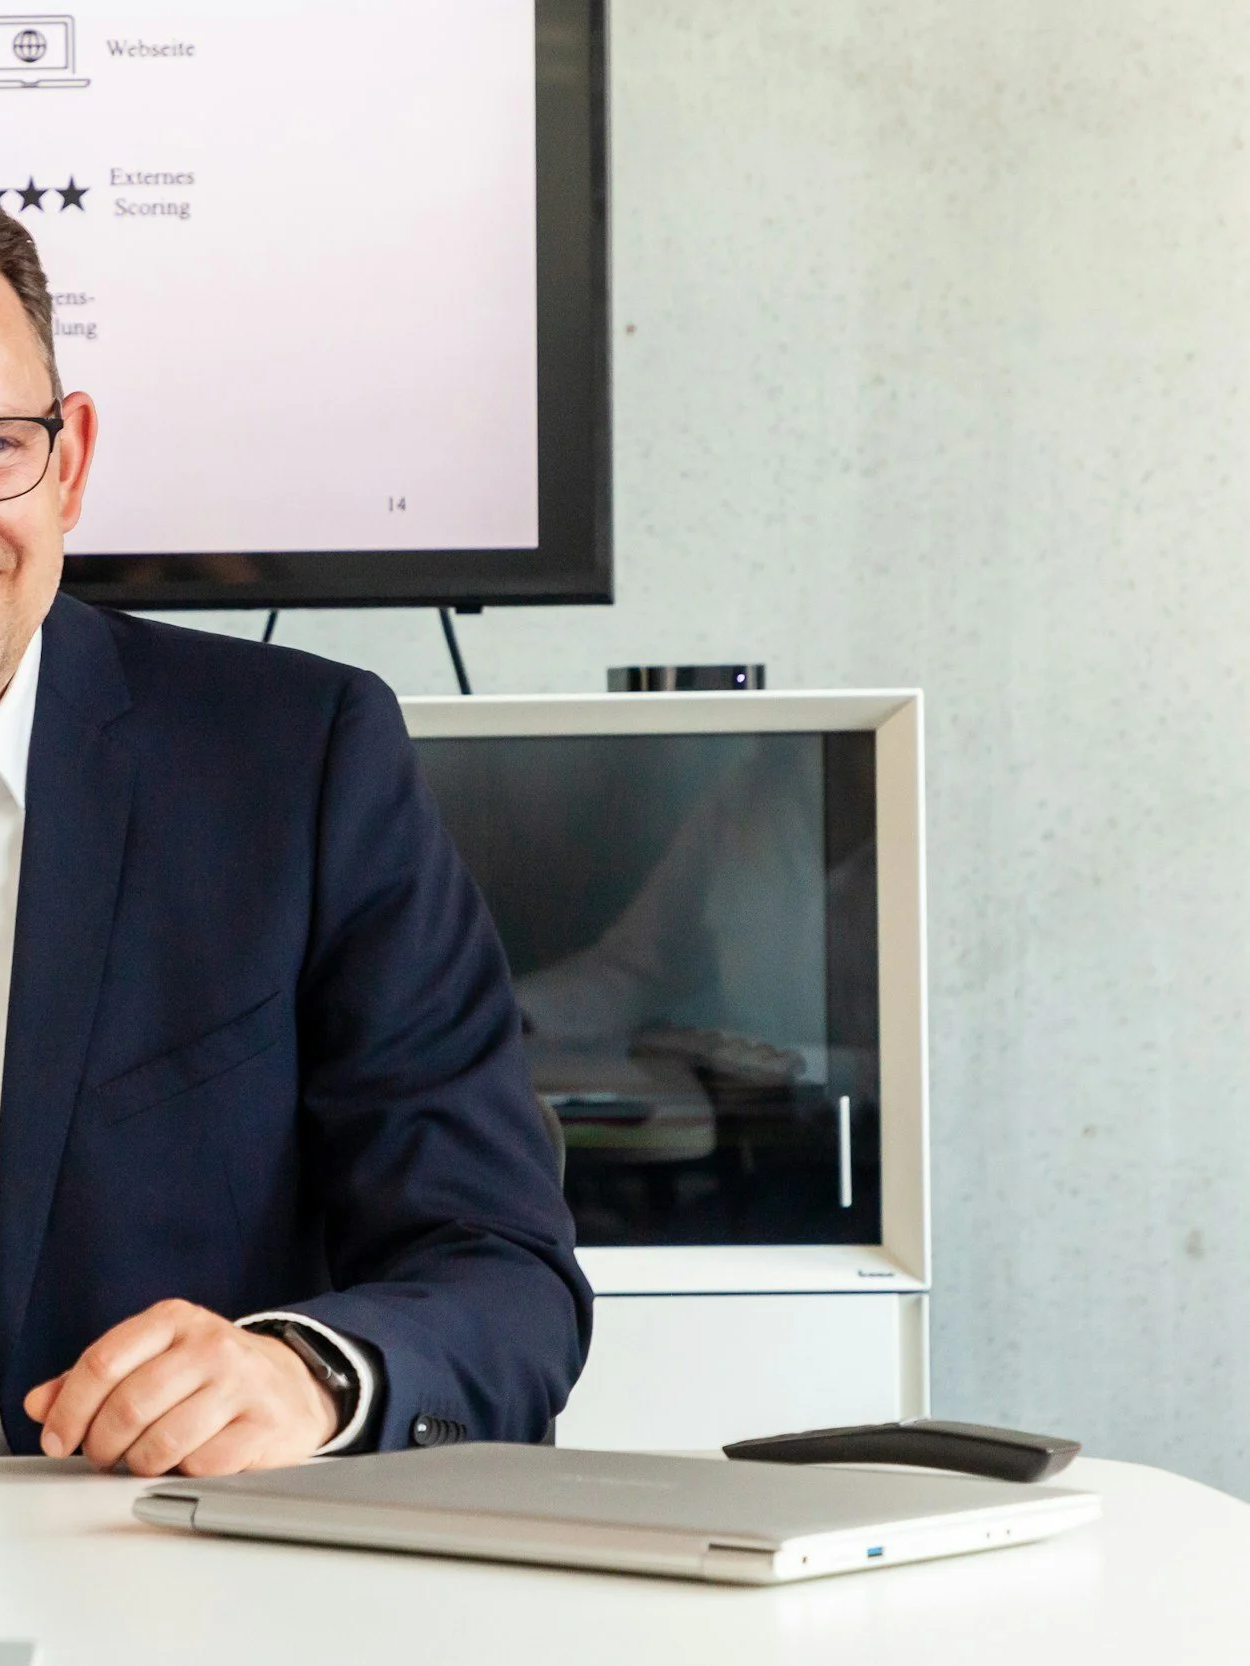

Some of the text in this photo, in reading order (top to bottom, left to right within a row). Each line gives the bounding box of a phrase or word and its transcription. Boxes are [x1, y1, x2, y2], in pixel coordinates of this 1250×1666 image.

[107, 39, 196, 58] Webseite
[110, 168, 196, 187] Externes
[114, 198, 191, 220] Scoring
[388, 496, 407, 512] 14
